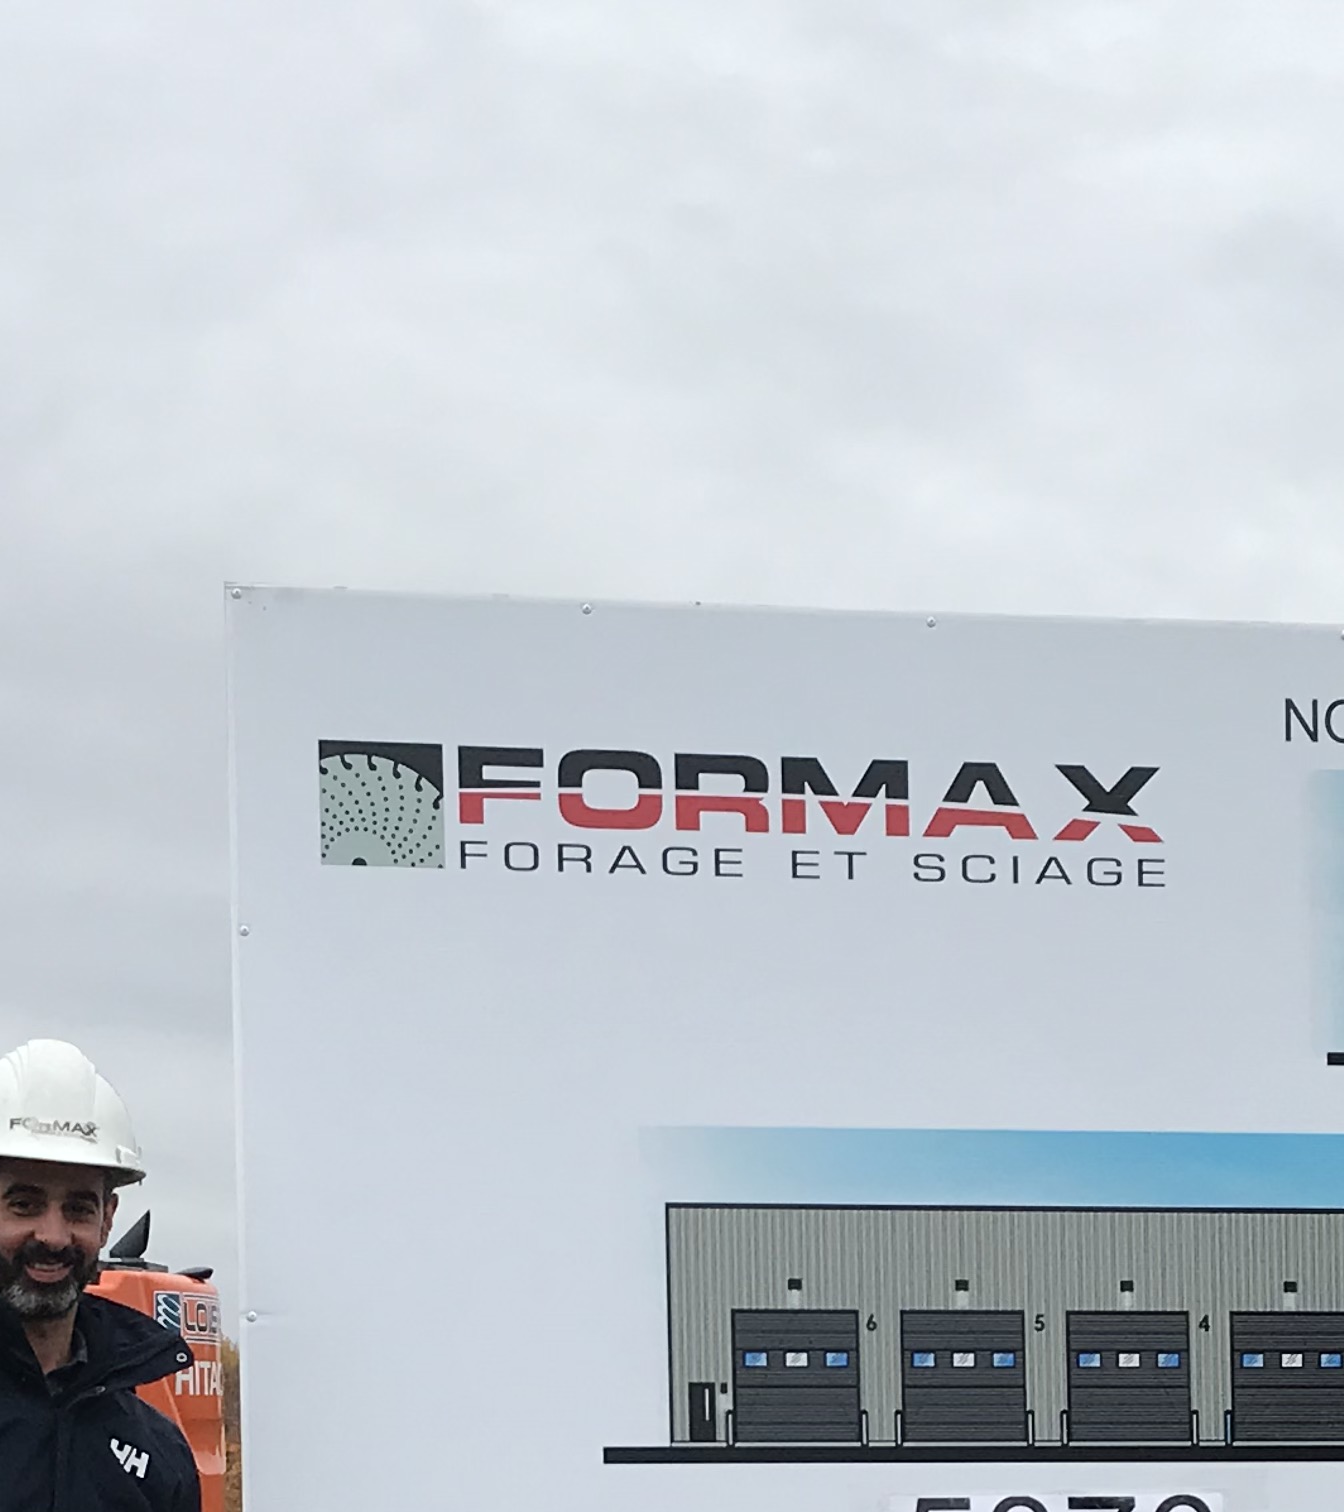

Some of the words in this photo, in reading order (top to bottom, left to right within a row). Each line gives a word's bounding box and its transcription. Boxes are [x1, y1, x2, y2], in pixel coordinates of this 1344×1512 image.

[457, 745, 1164, 844] FORMAX
[460, 840, 744, 879] FORAGE
[791, 850, 868, 881] ET
[913, 853, 1166, 889] SCIAGE
[866, 1313, 879, 1333] 6
[1034, 1314, 1046, 1333] 5
[1198, 1314, 1211, 1333] 4
